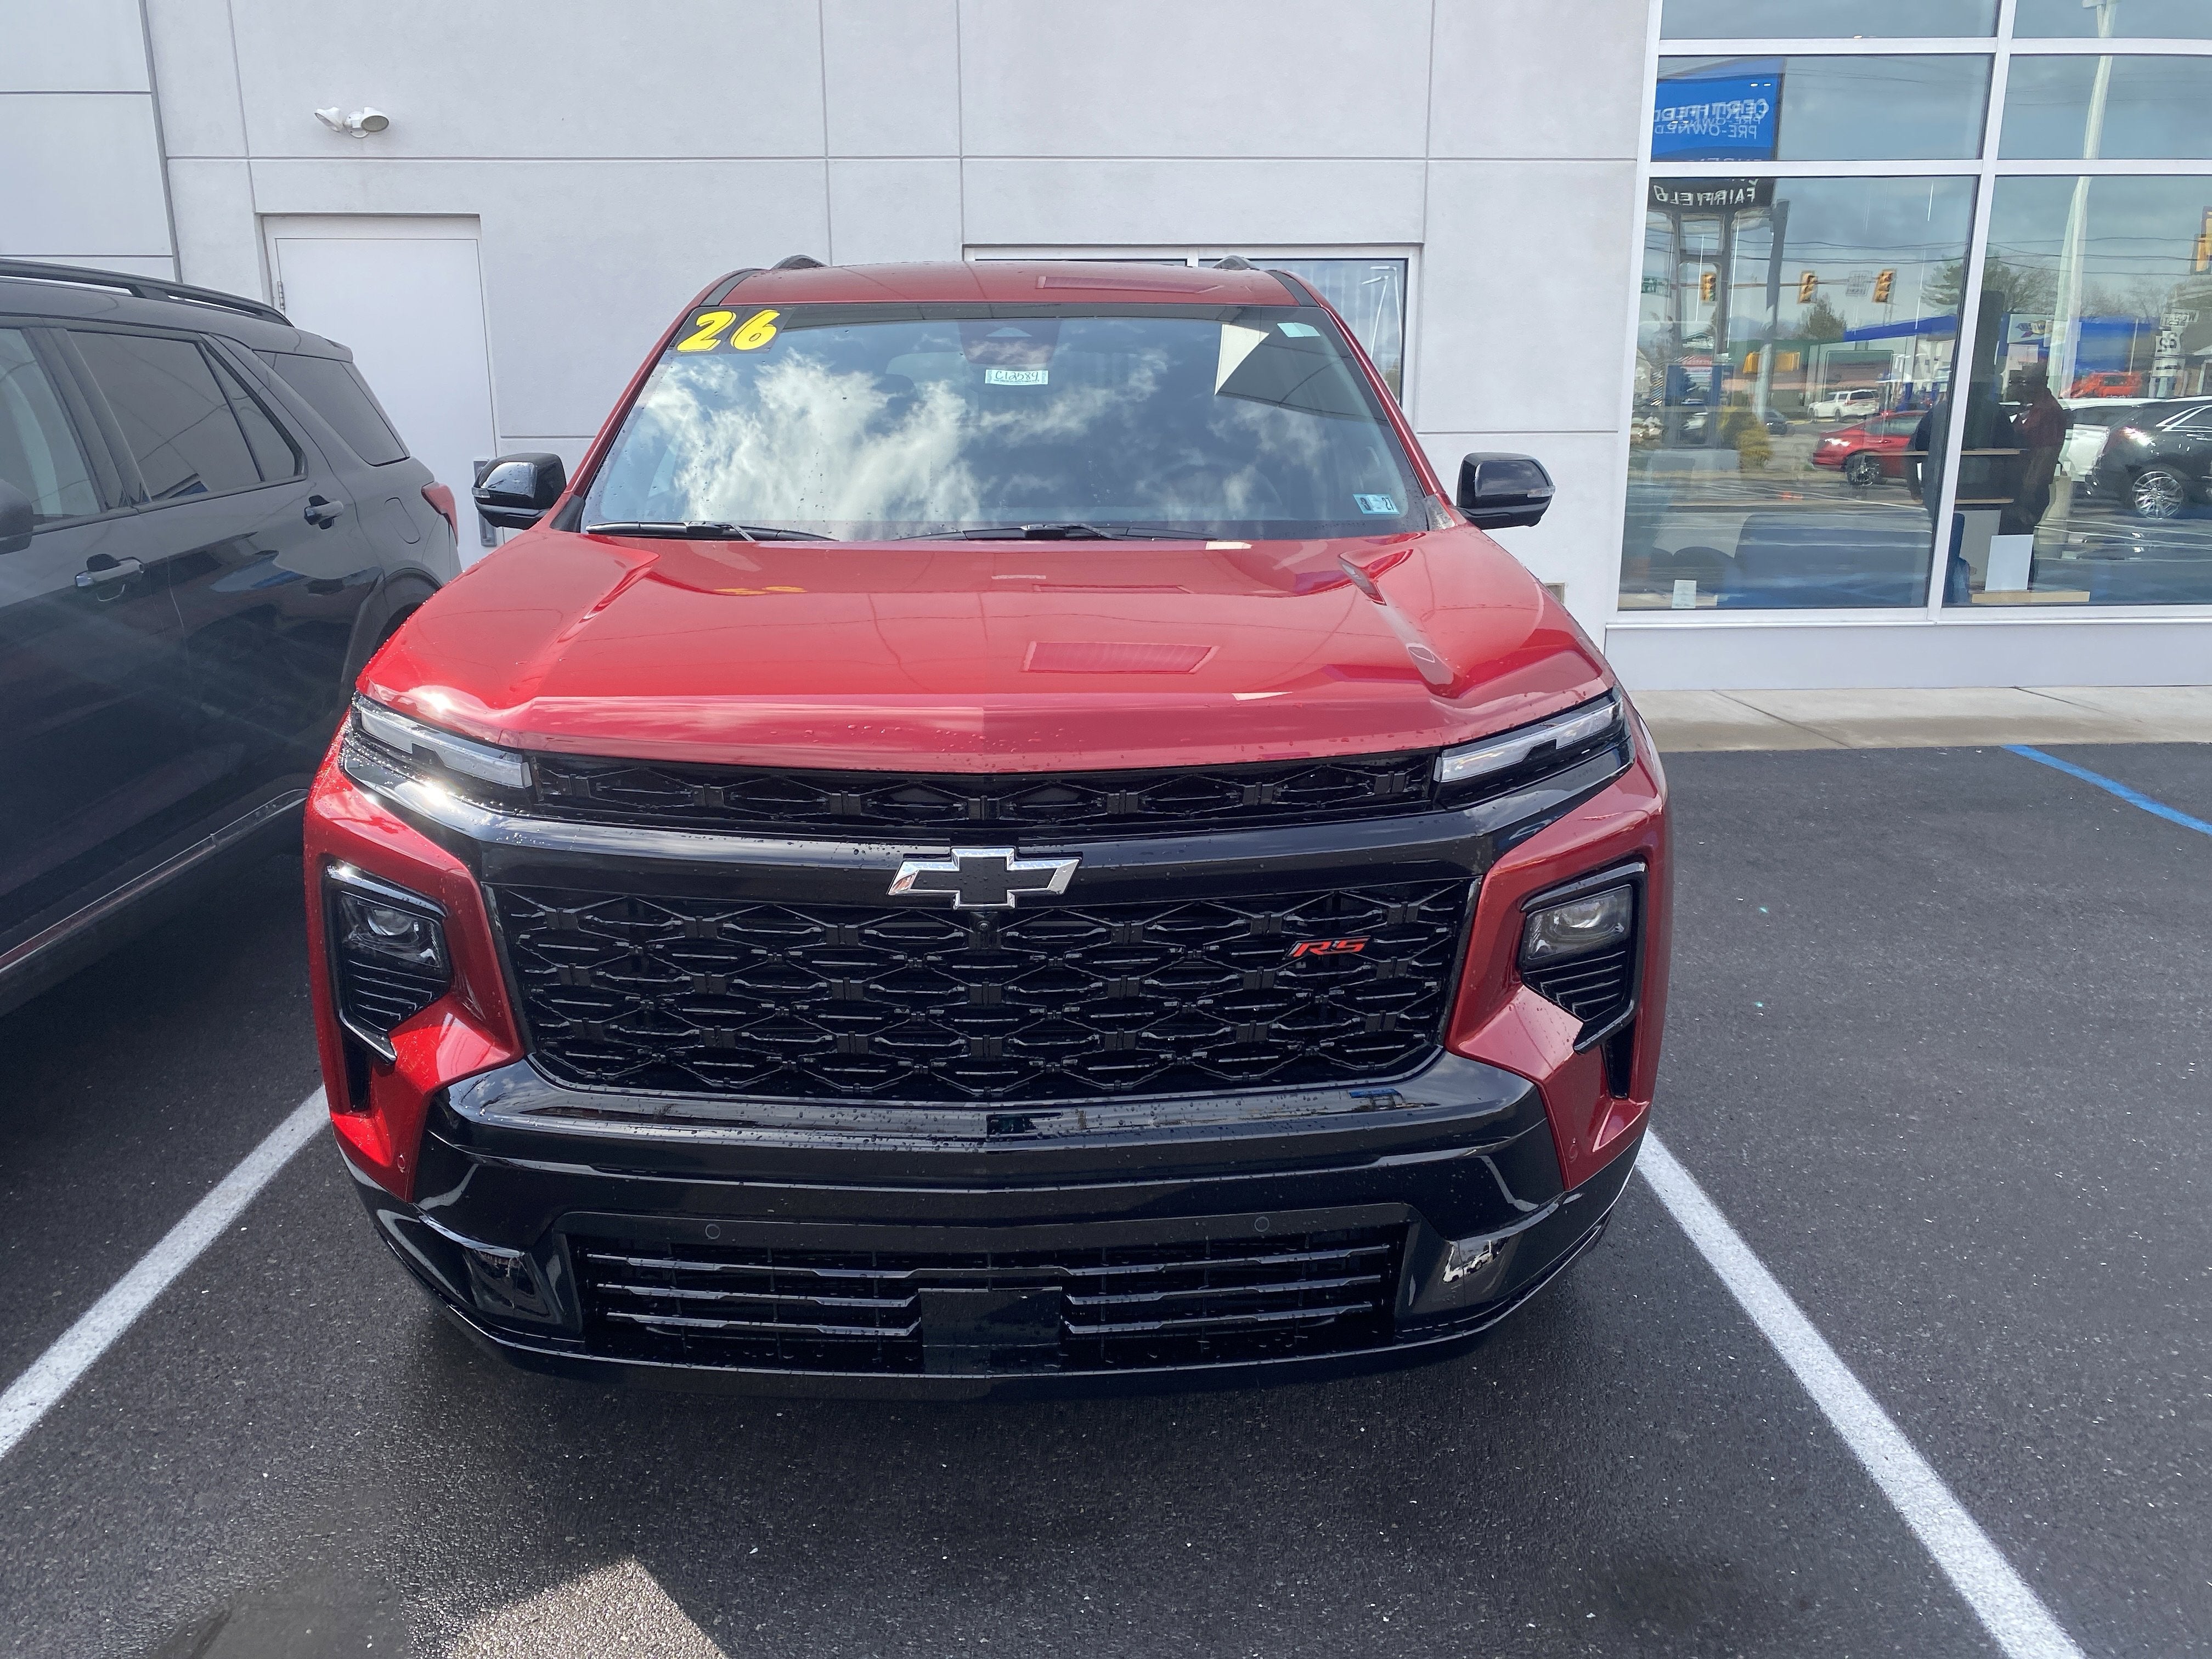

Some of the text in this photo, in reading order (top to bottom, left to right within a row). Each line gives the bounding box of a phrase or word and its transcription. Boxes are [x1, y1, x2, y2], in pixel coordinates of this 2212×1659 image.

[677, 309, 781, 352] 26
[995, 370, 1039, 381] C12589
[1288, 936, 1371, 957] RS
